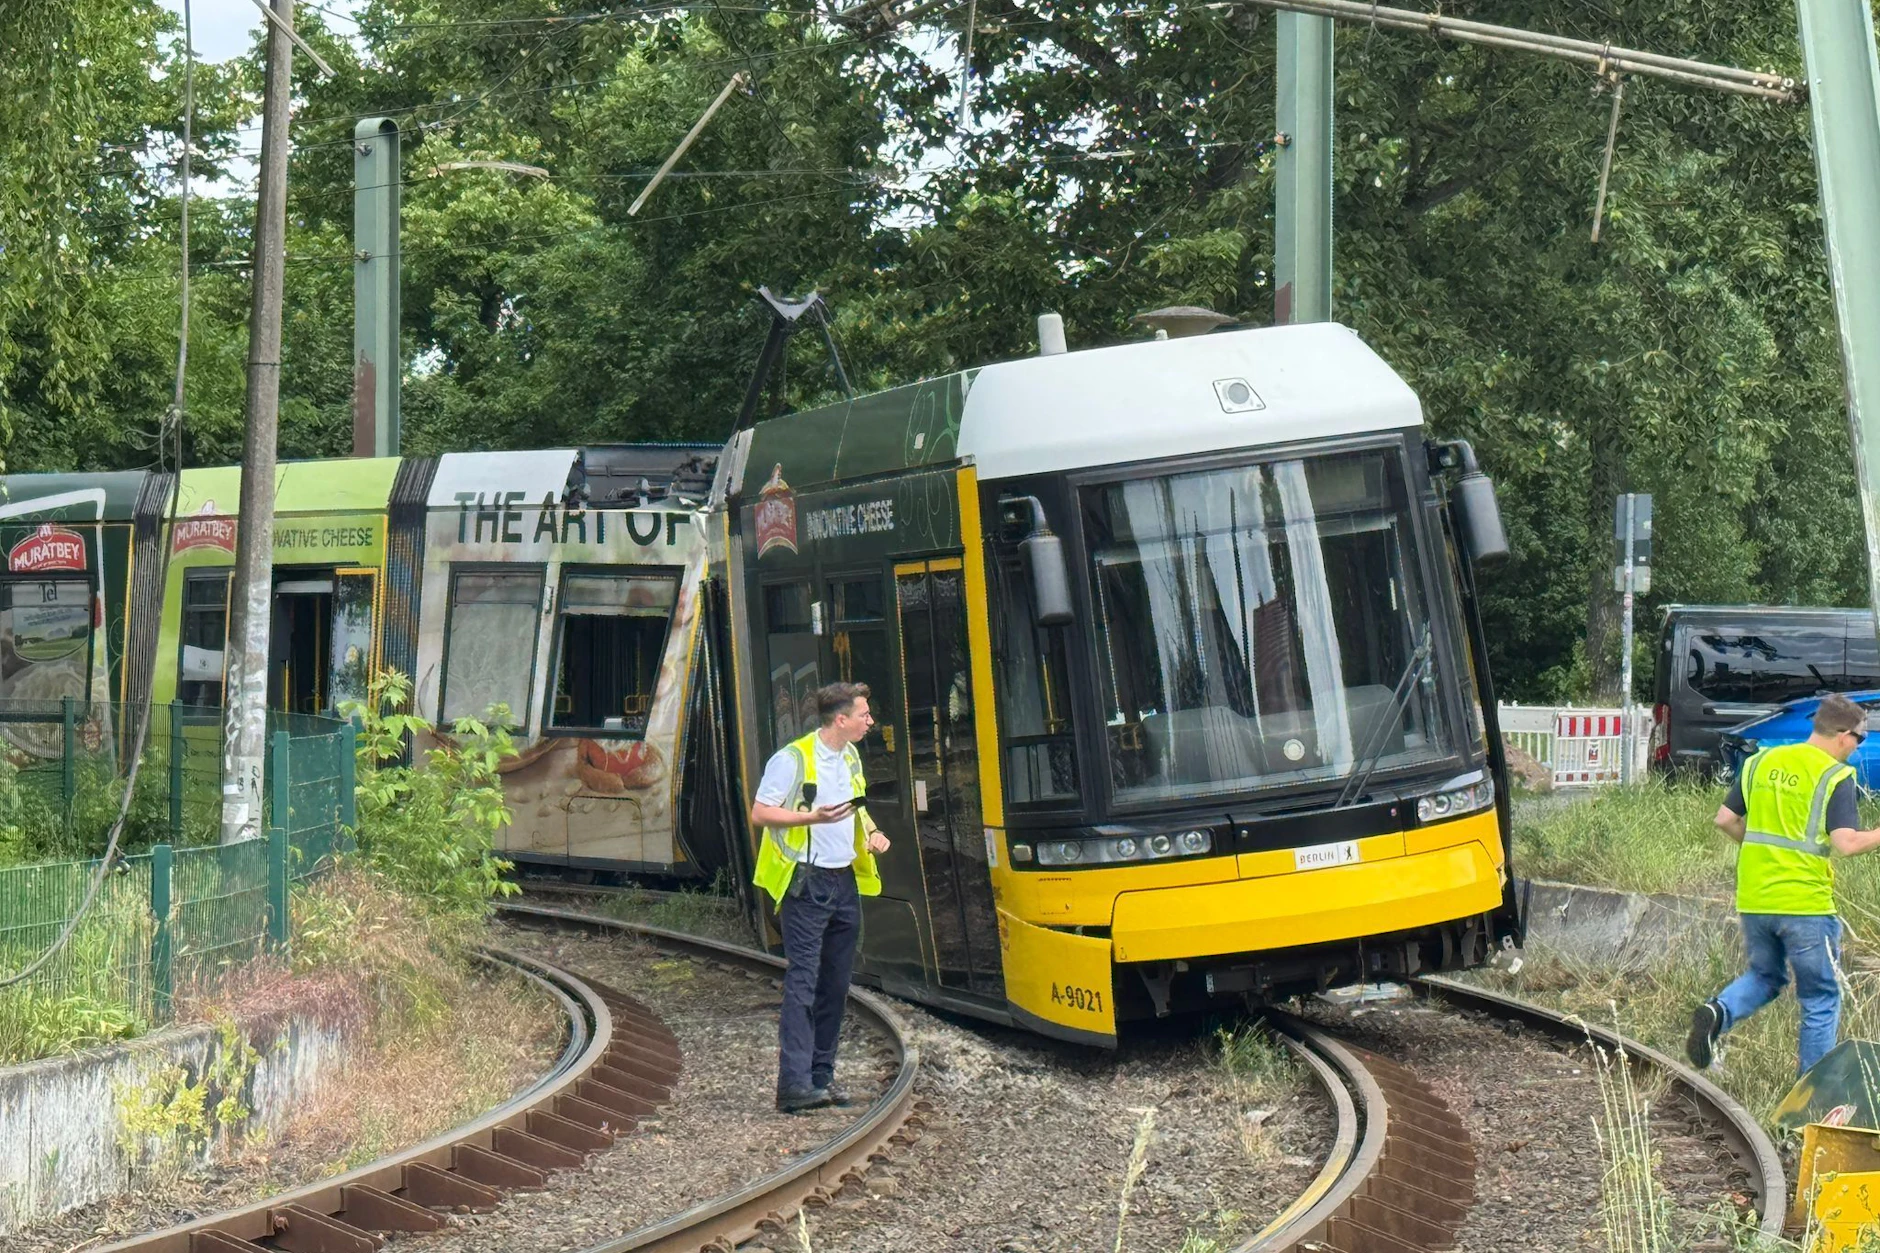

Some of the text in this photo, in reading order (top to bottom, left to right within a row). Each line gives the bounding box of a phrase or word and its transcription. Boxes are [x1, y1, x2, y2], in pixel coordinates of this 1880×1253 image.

[453, 491, 526, 544] THE
[625, 511, 691, 546] OF
[857, 499, 895, 535] CHEESE
[177, 520, 233, 545] MURATBEY
[322, 527, 374, 548] CHEESE
[14, 541, 80, 572] MURATBEY
[1769, 768, 1800, 787] BVG
[1300, 850, 1335, 864] BERLIN
[1051, 982, 1103, 1013] A-9021
